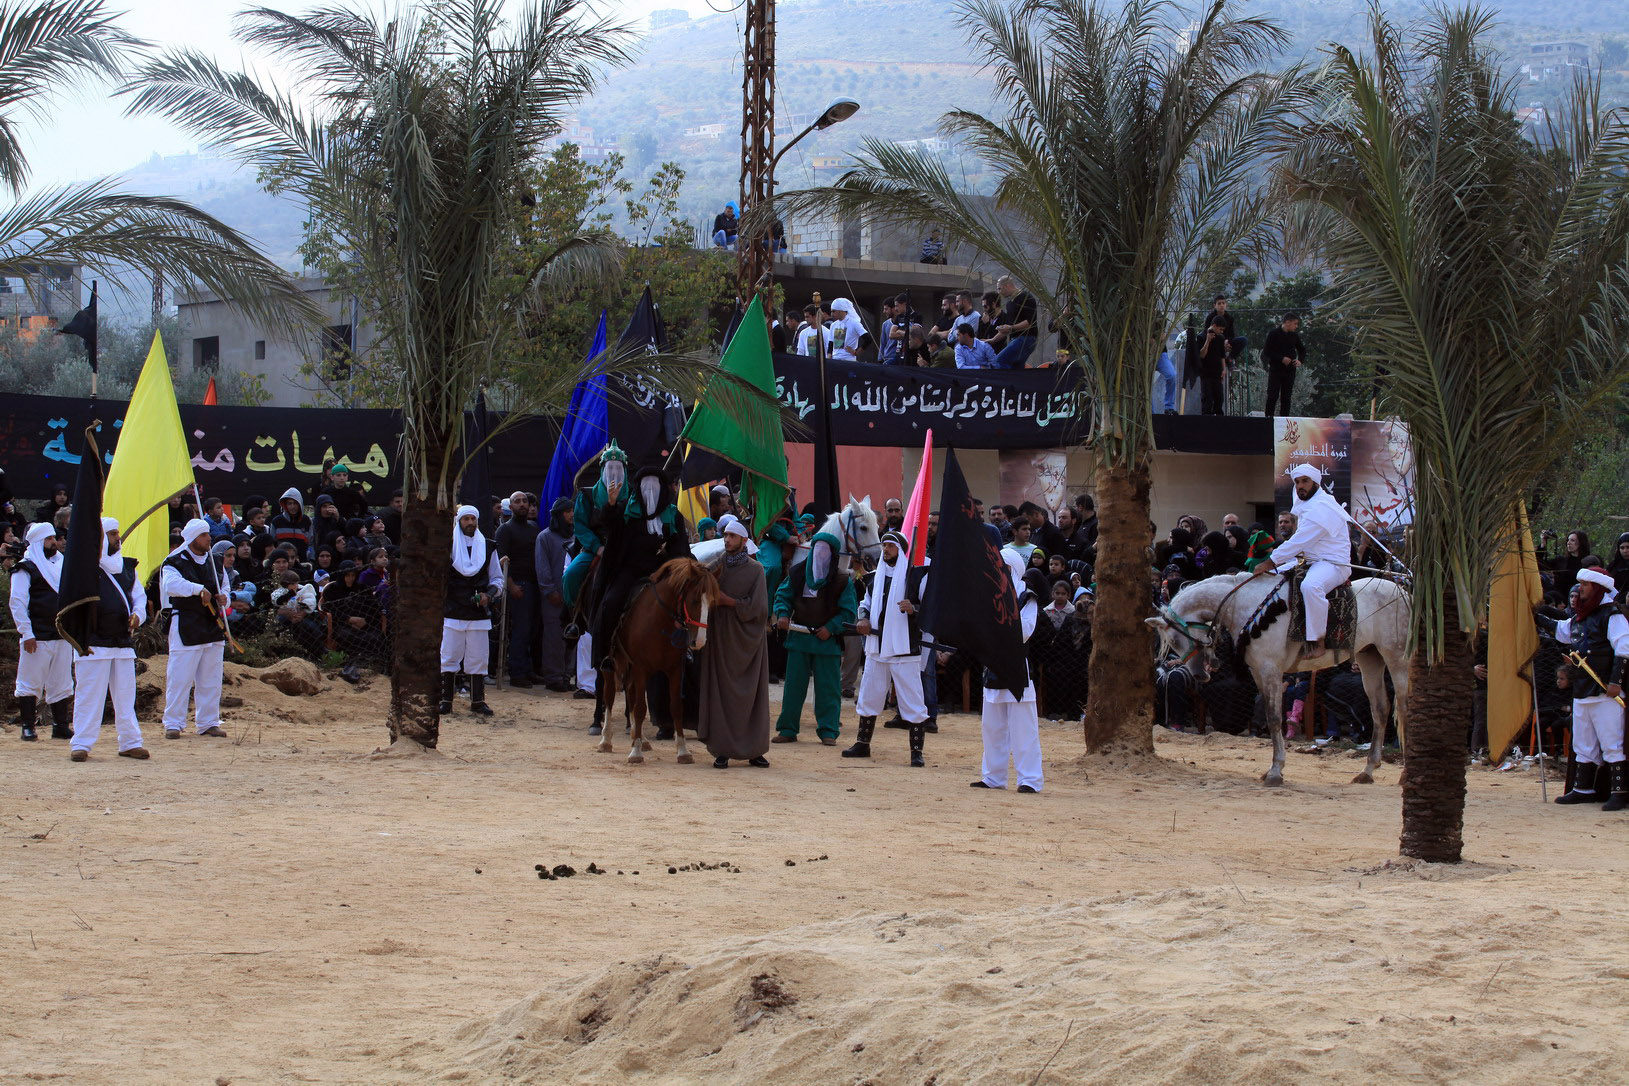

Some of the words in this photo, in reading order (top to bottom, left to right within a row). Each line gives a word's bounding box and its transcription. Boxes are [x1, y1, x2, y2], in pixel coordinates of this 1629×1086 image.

[776, 376, 849, 420] الهادة
[891, 385, 917, 414] من
[920, 384, 979, 418] وكرامتنا
[981, 386, 1015, 418] عادة
[1017, 391, 1037, 418] لنا
[189, 429, 236, 473] من
[1289, 443, 1329, 460] المظلومين
[1331, 444, 1347, 461] ثورة
